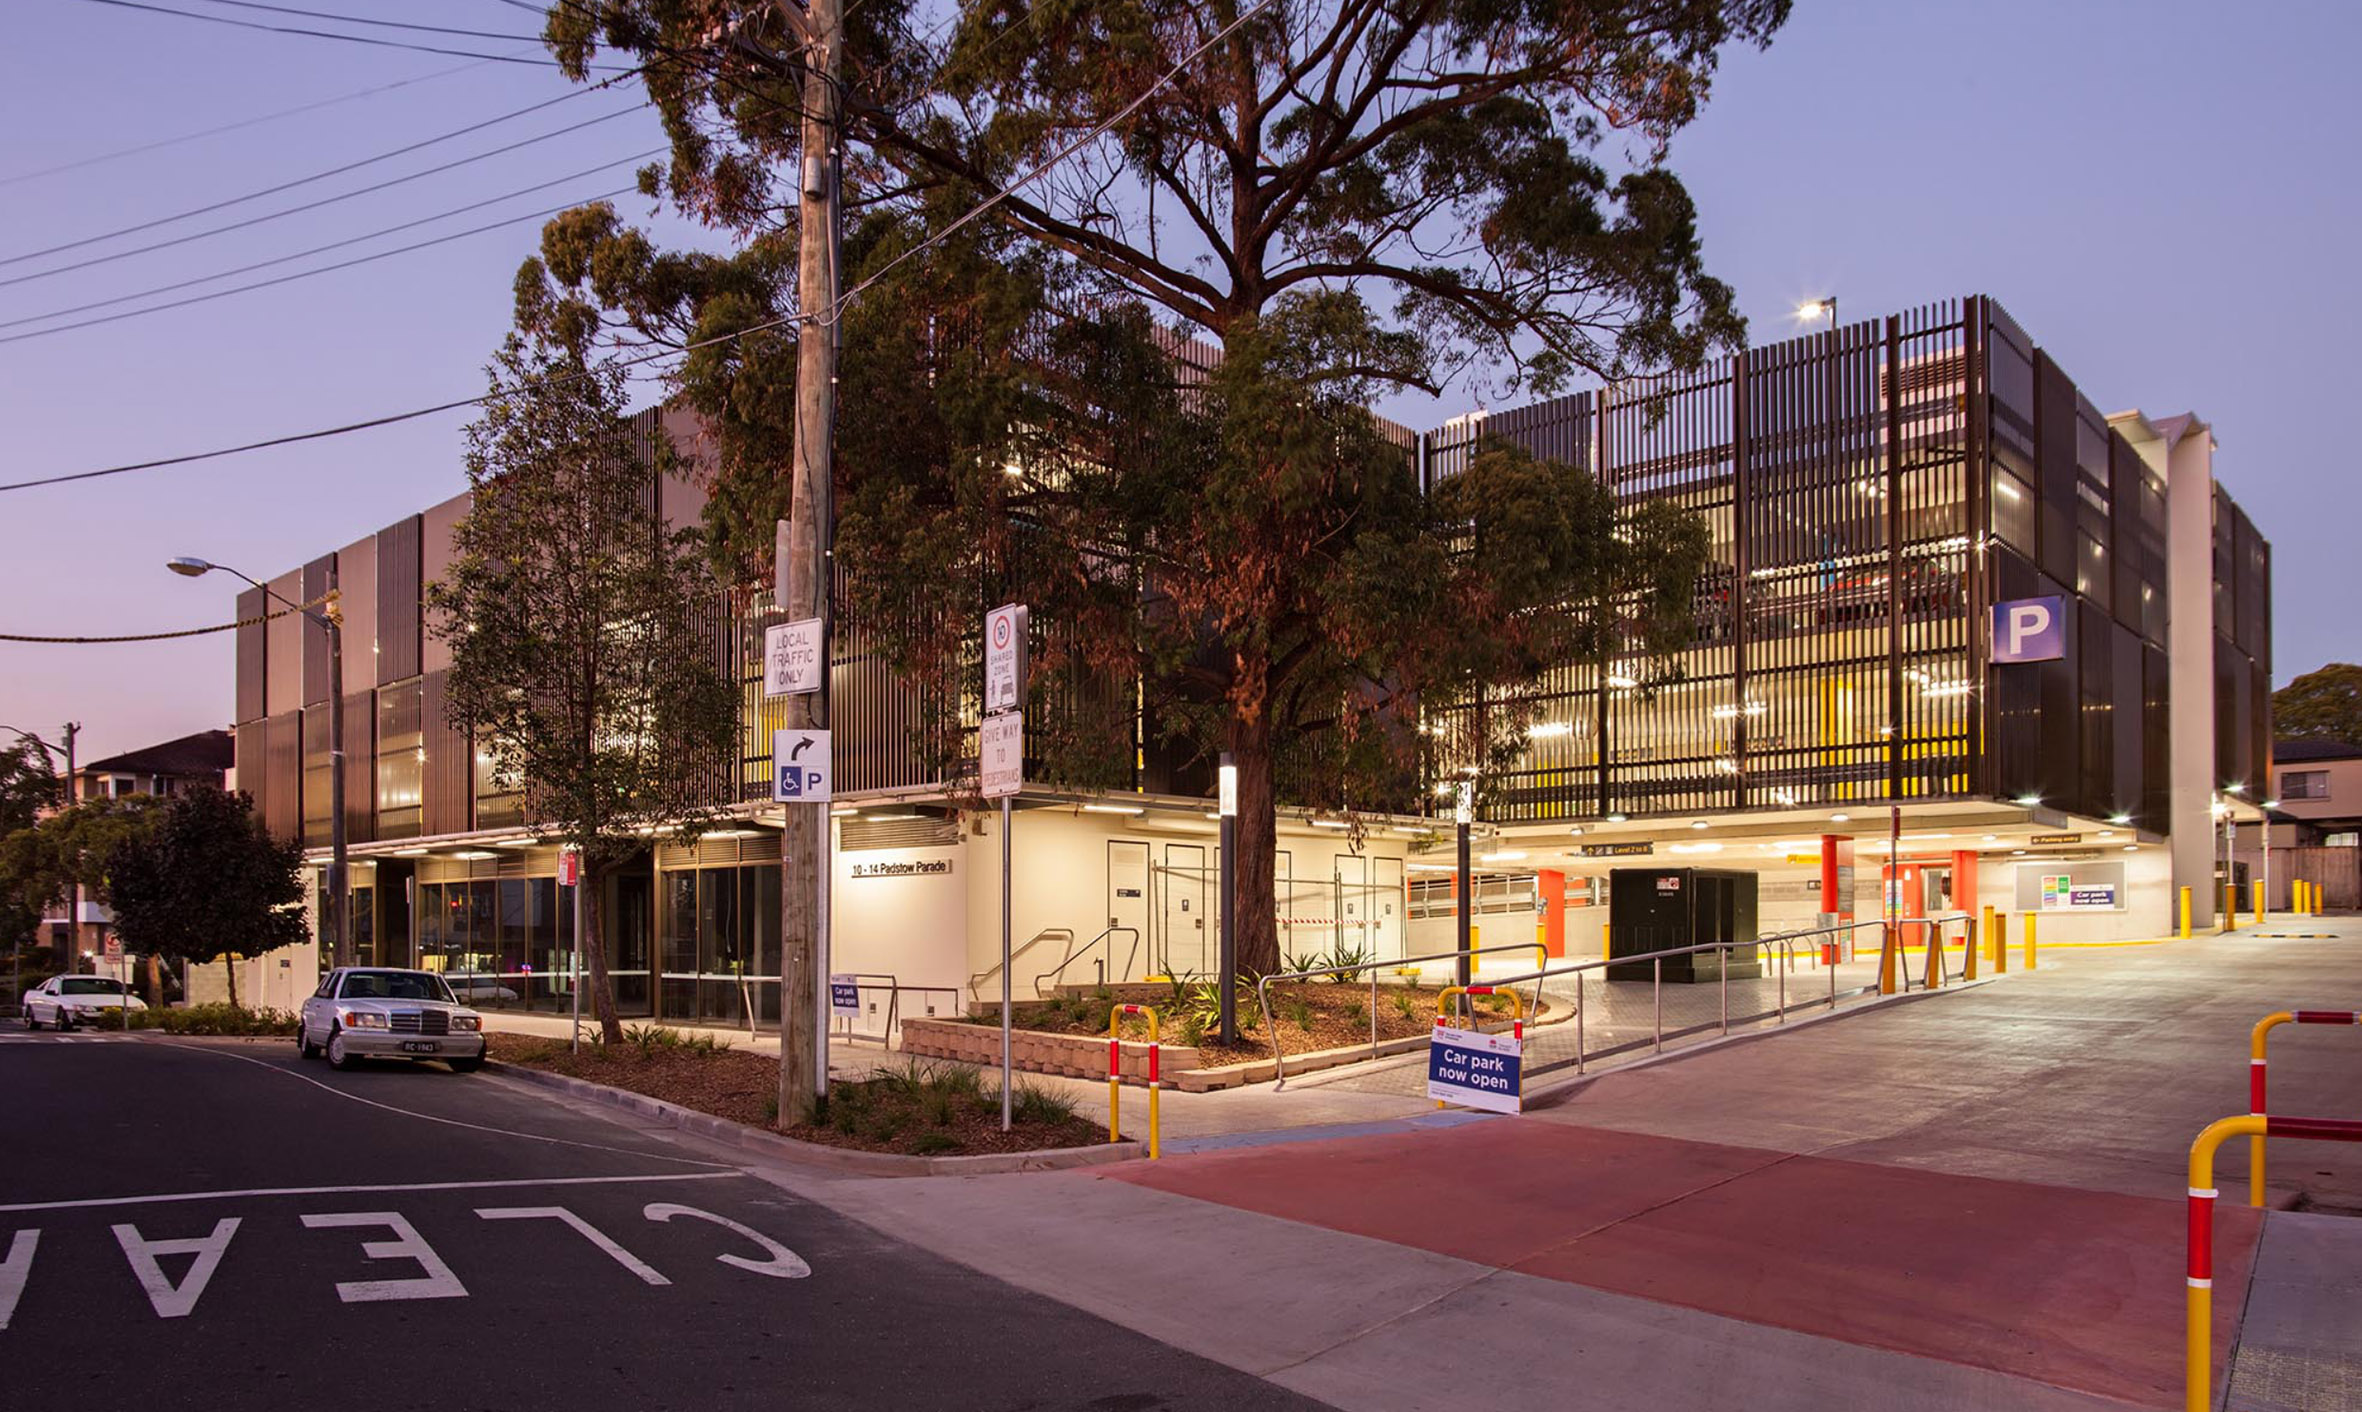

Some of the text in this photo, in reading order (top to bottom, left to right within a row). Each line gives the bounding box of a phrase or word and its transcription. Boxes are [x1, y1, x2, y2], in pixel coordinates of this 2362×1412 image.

[2010, 605, 2050, 655] P
[776, 631, 809, 650] LOCAL
[772, 648, 814, 668] TRAFFIC
[990, 649, 1013, 666] SHARED
[778, 668, 805, 686] ONLY
[984, 722, 1019, 745] GIVE WAY
[997, 746, 1006, 764] TO
[808, 772, 823, 791] P
[852, 864, 862, 875] 10
[869, 863, 879, 875] 14
[880, 861, 915, 874] Padstow
[916, 859, 947, 873] Parade
[1444, 1049, 1504, 1072] Car park
[1439, 1067, 1508, 1090] now open
